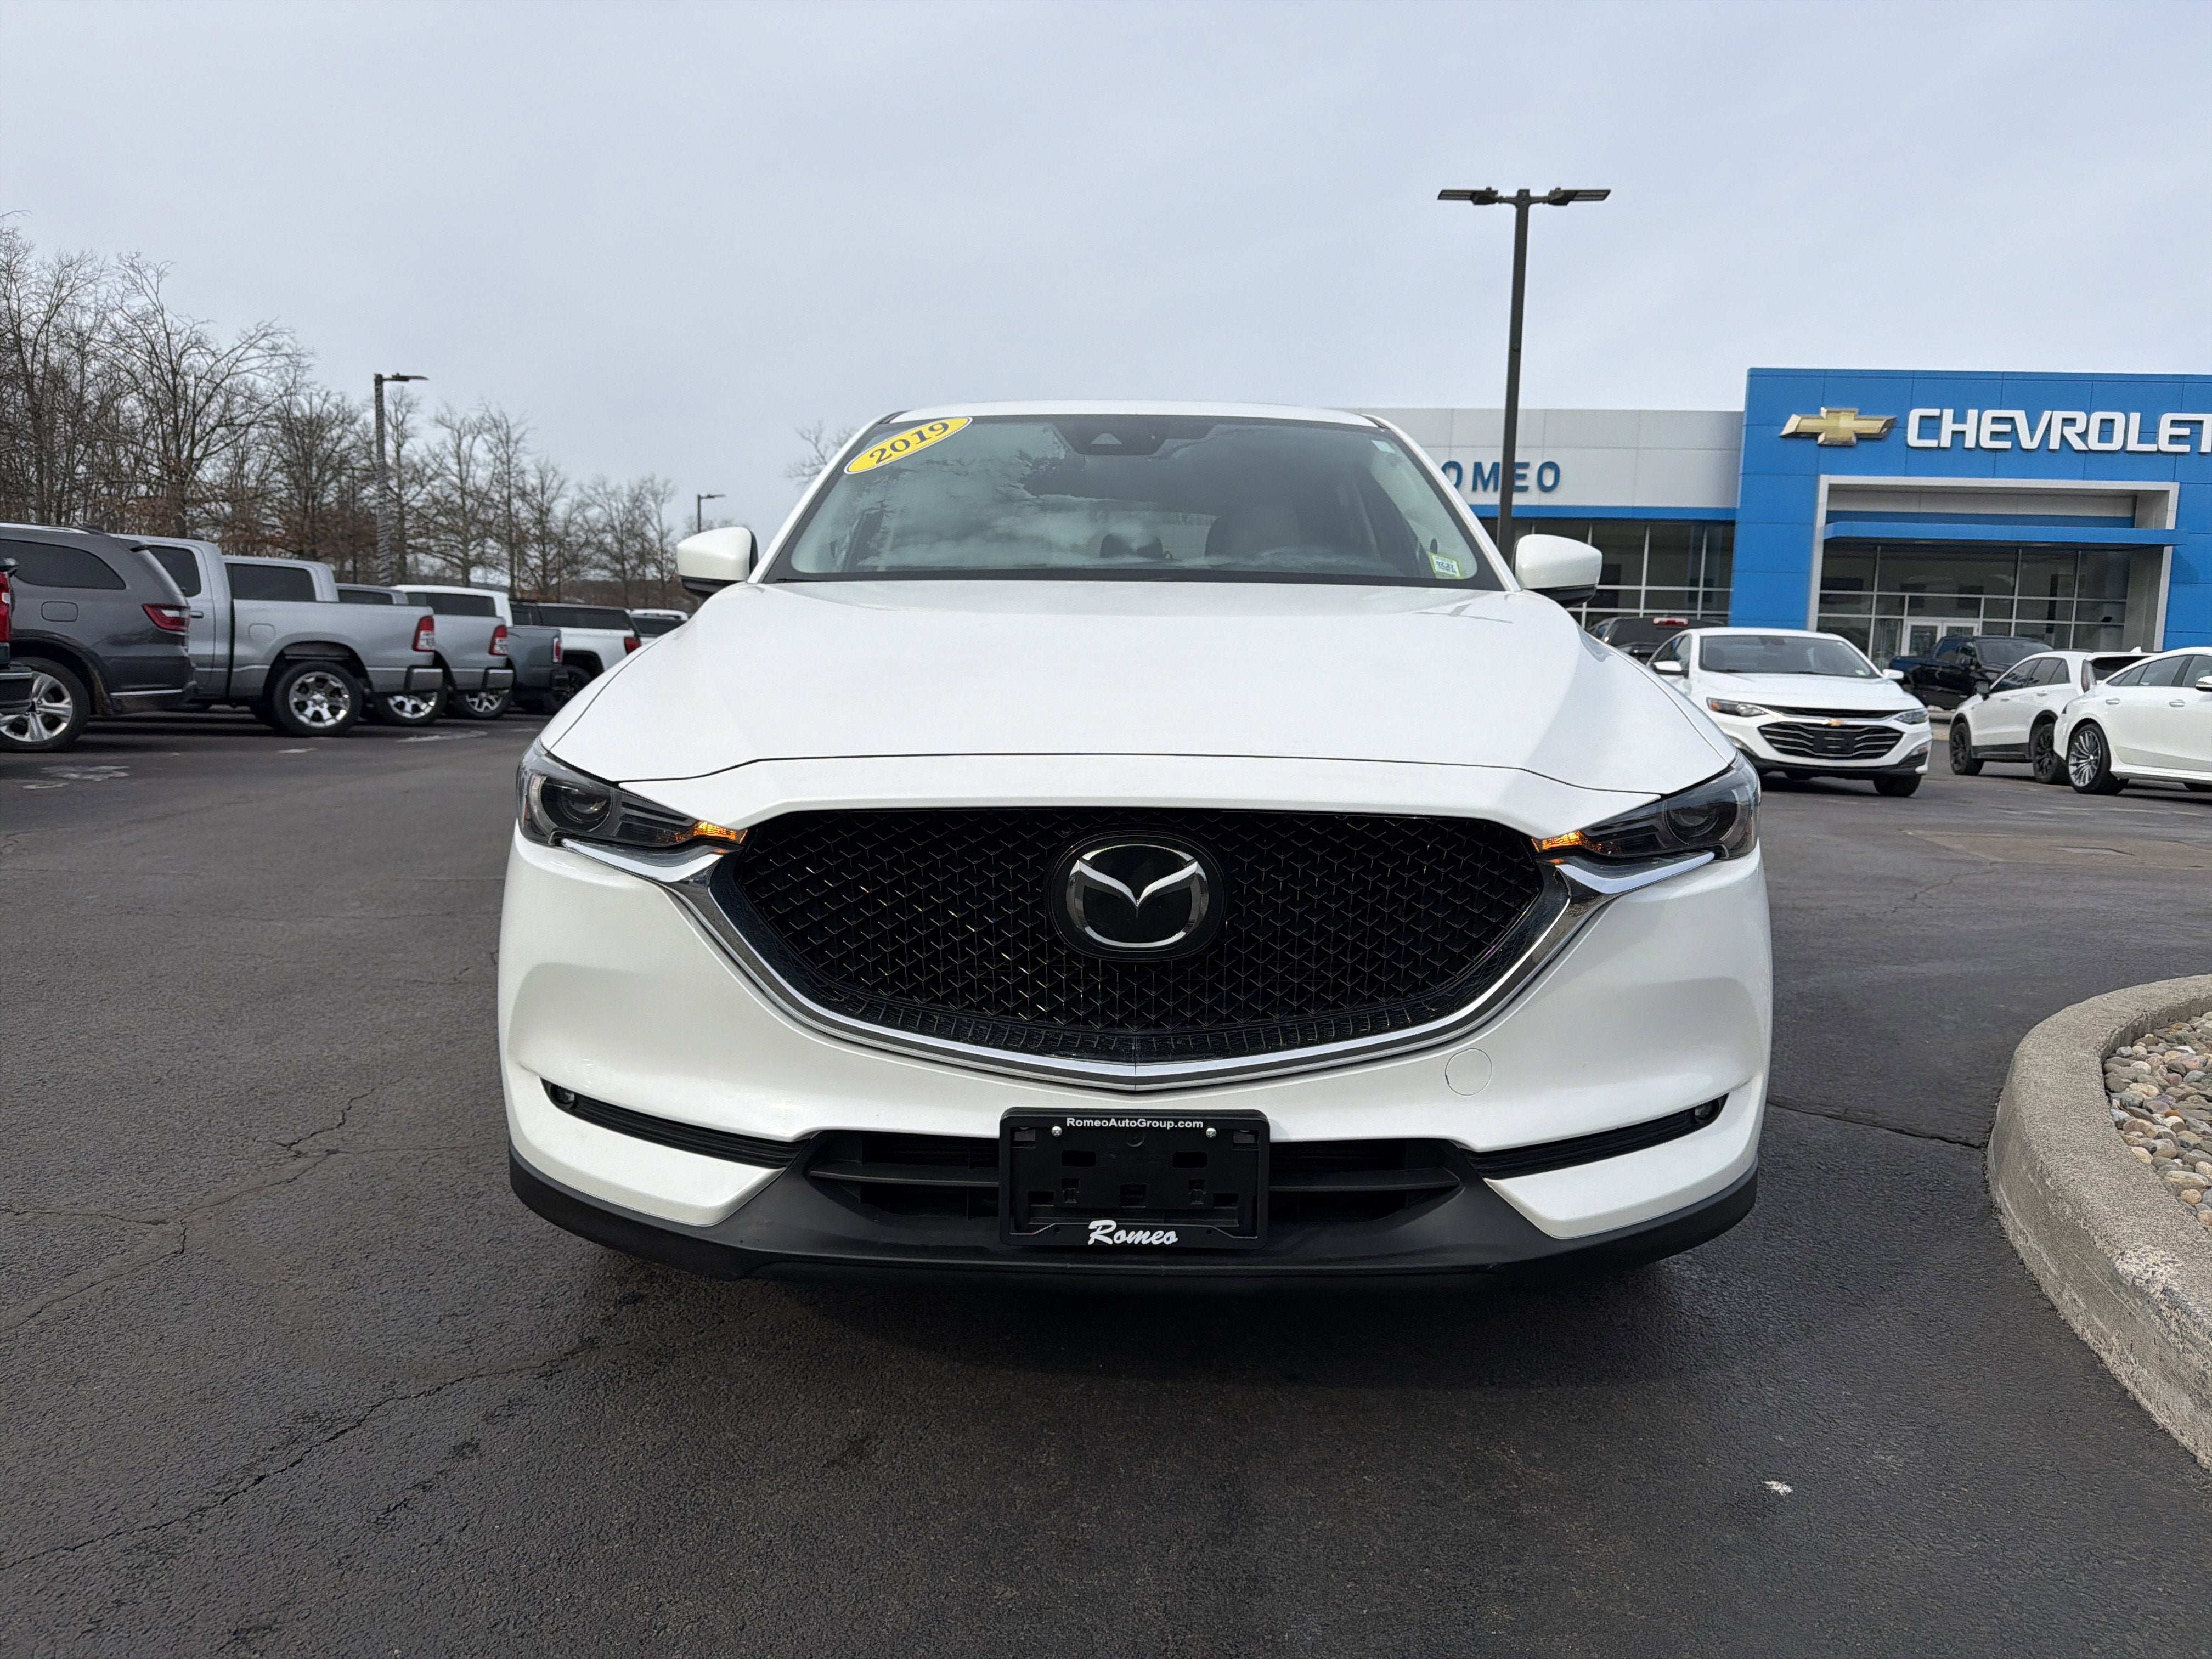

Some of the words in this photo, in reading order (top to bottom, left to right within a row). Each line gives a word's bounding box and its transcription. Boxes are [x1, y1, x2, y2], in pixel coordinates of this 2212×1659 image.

[869, 422, 949, 464] 2019
[1441, 461, 1561, 493] OMEO
[1066, 1118, 1204, 1129] RomeoAutoGroup.com
[1087, 1220, 1178, 1245] Romeo
